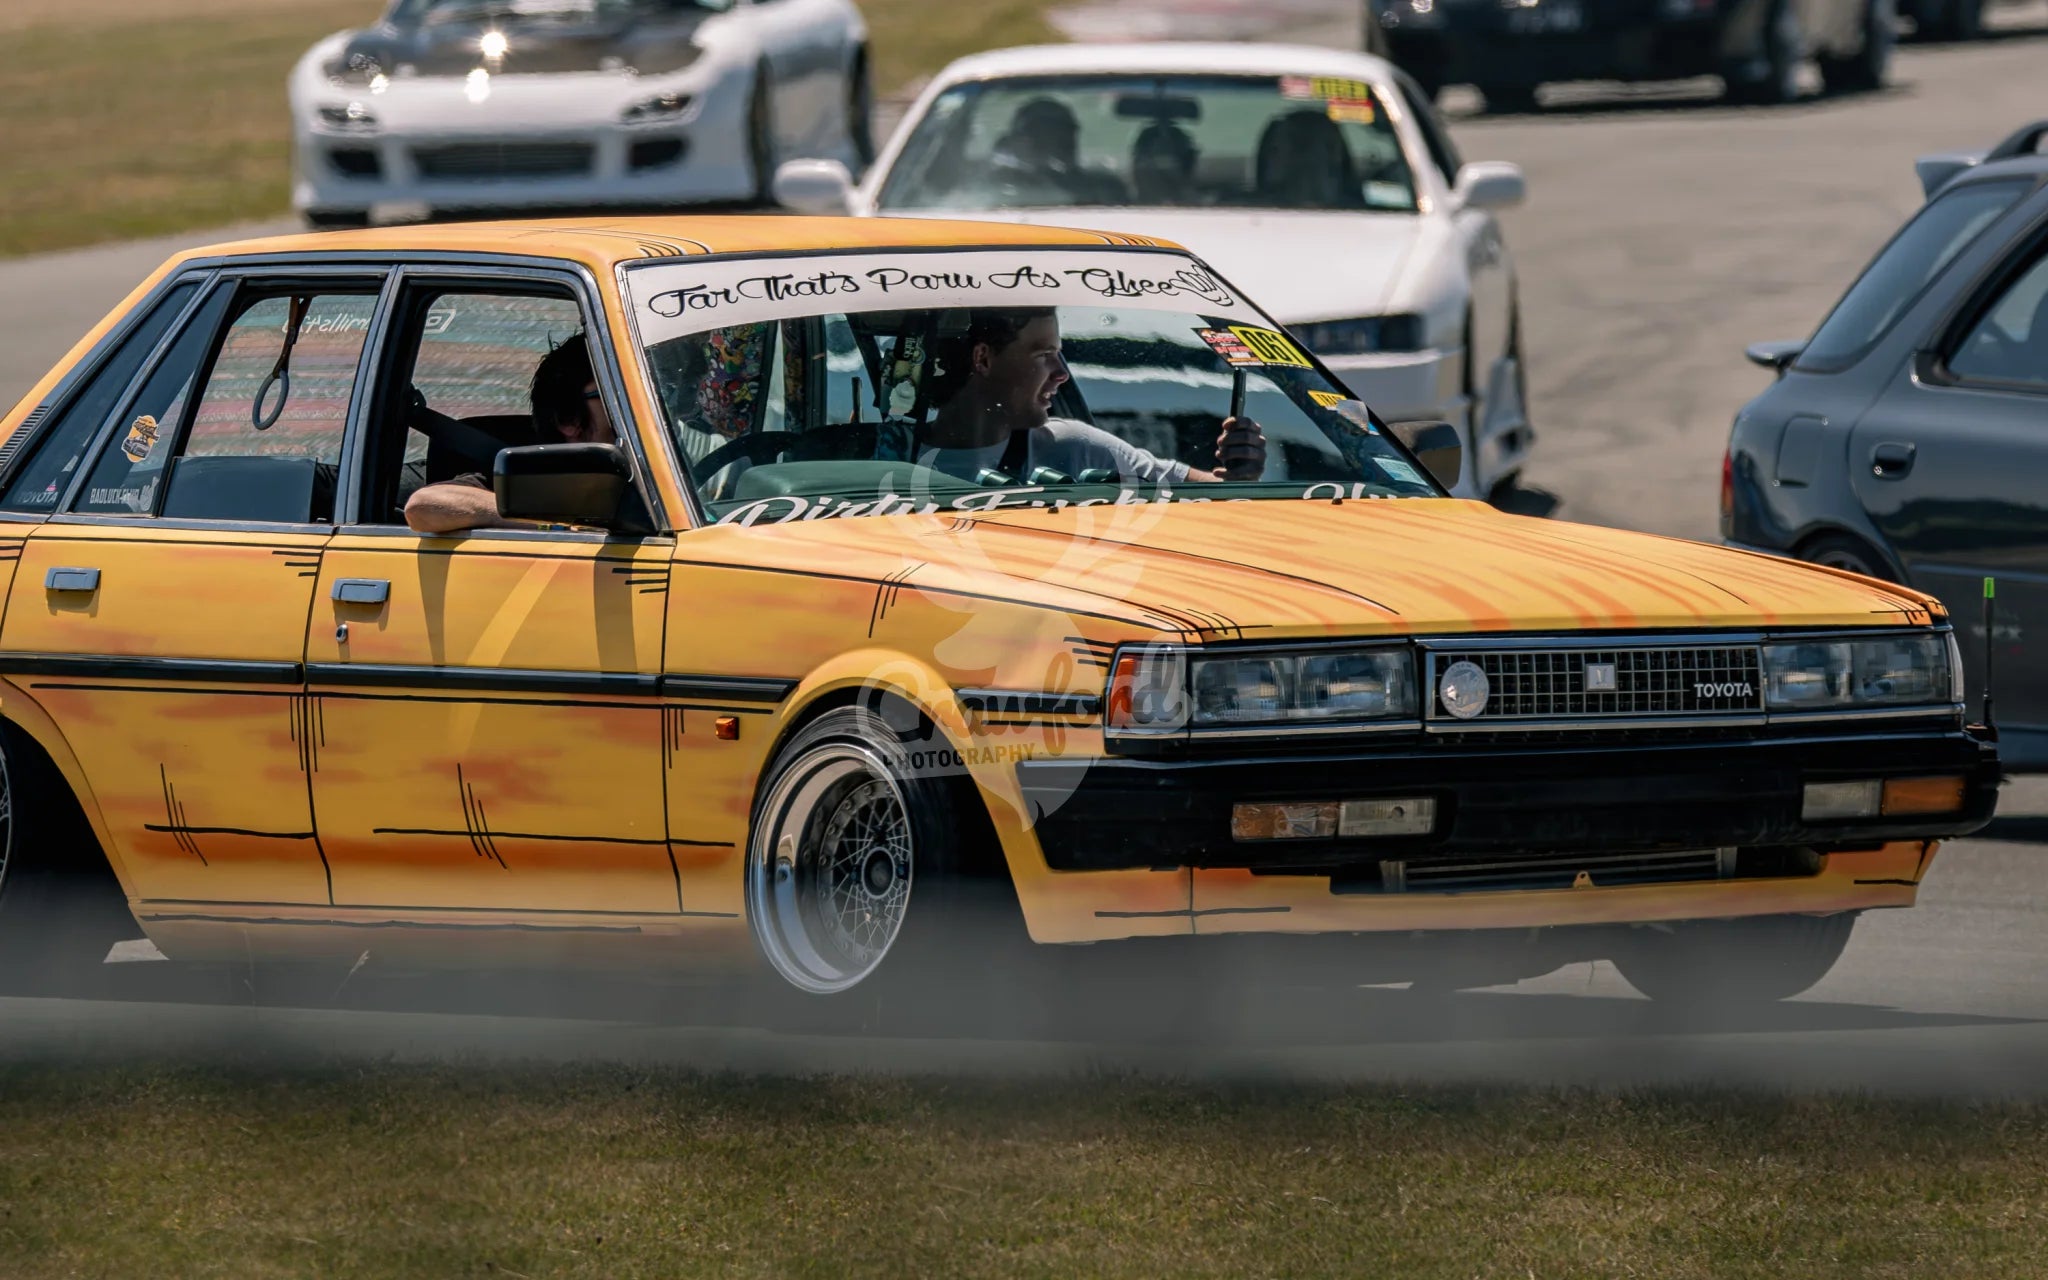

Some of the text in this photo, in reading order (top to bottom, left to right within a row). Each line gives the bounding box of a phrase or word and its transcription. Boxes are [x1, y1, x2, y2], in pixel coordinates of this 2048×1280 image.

[737, 270, 860, 302] That's
[866, 267, 981, 293] Paru
[988, 265, 1061, 289] As
[1063, 267, 1174, 298] Ghee
[1238, 329, 1304, 365] 061
[1694, 682, 1753, 698] TOYOTA
